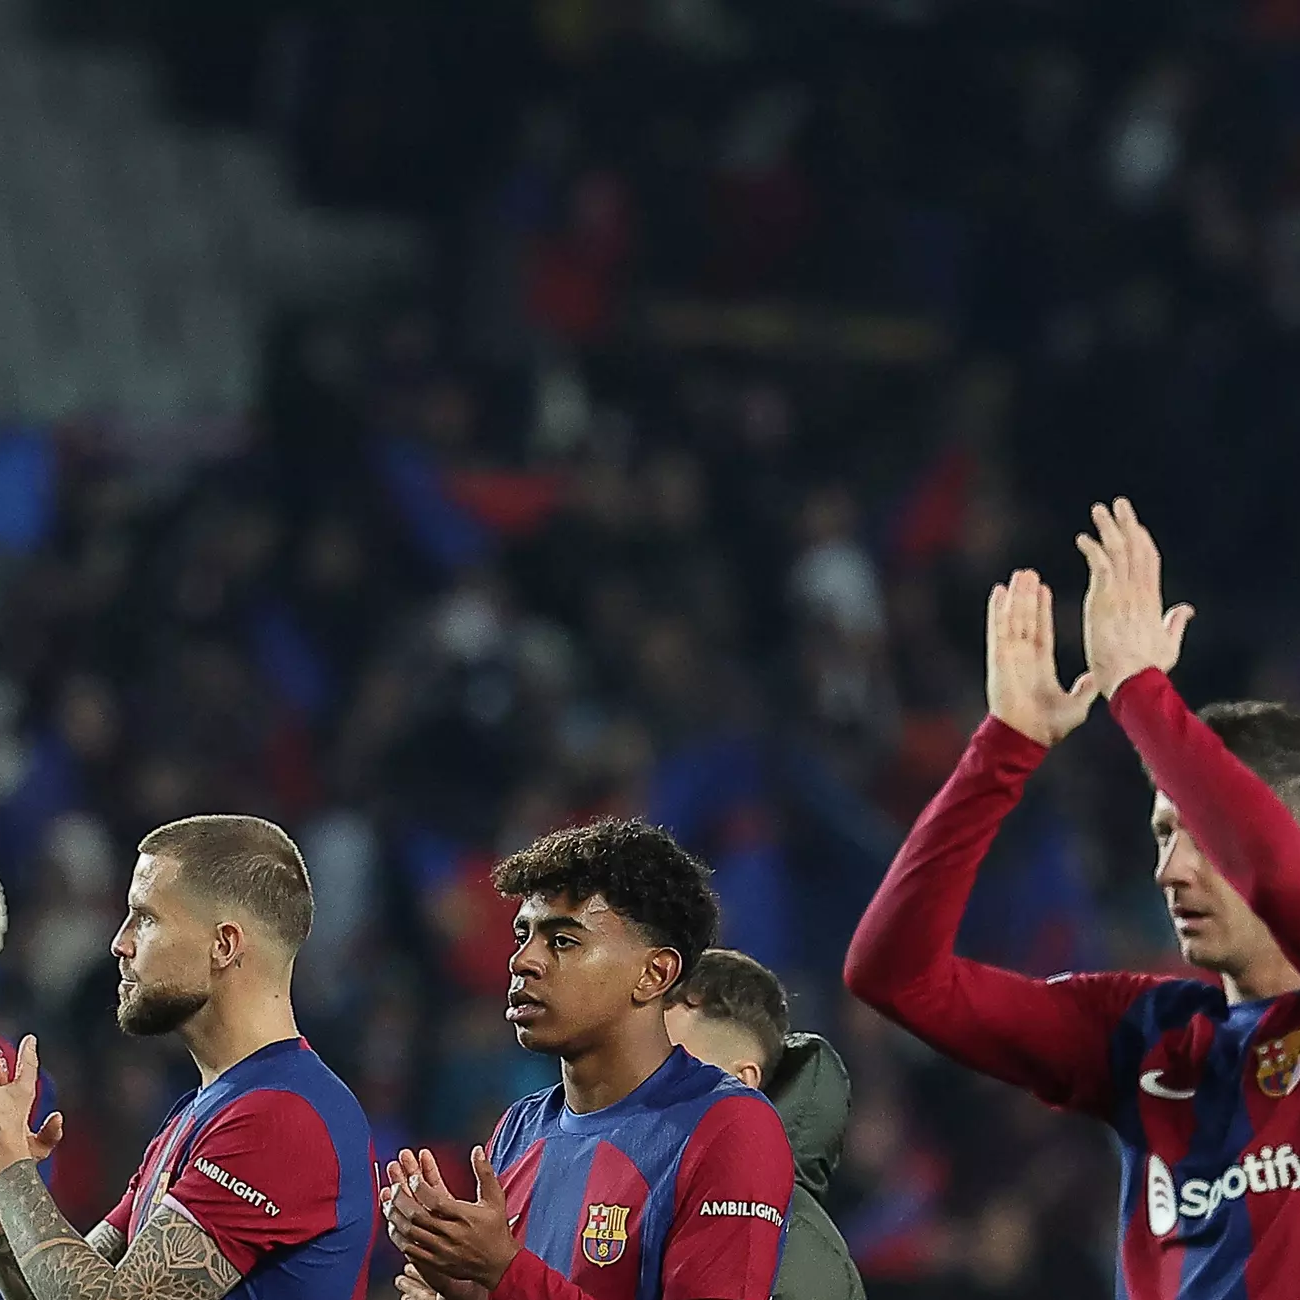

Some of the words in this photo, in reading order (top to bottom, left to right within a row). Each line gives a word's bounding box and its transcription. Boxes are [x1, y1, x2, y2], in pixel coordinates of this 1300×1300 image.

[194, 1157, 267, 1207] AMBILIGHT
[264, 1201, 281, 1217] tv
[700, 1201, 777, 1223] AMBILIGHT
